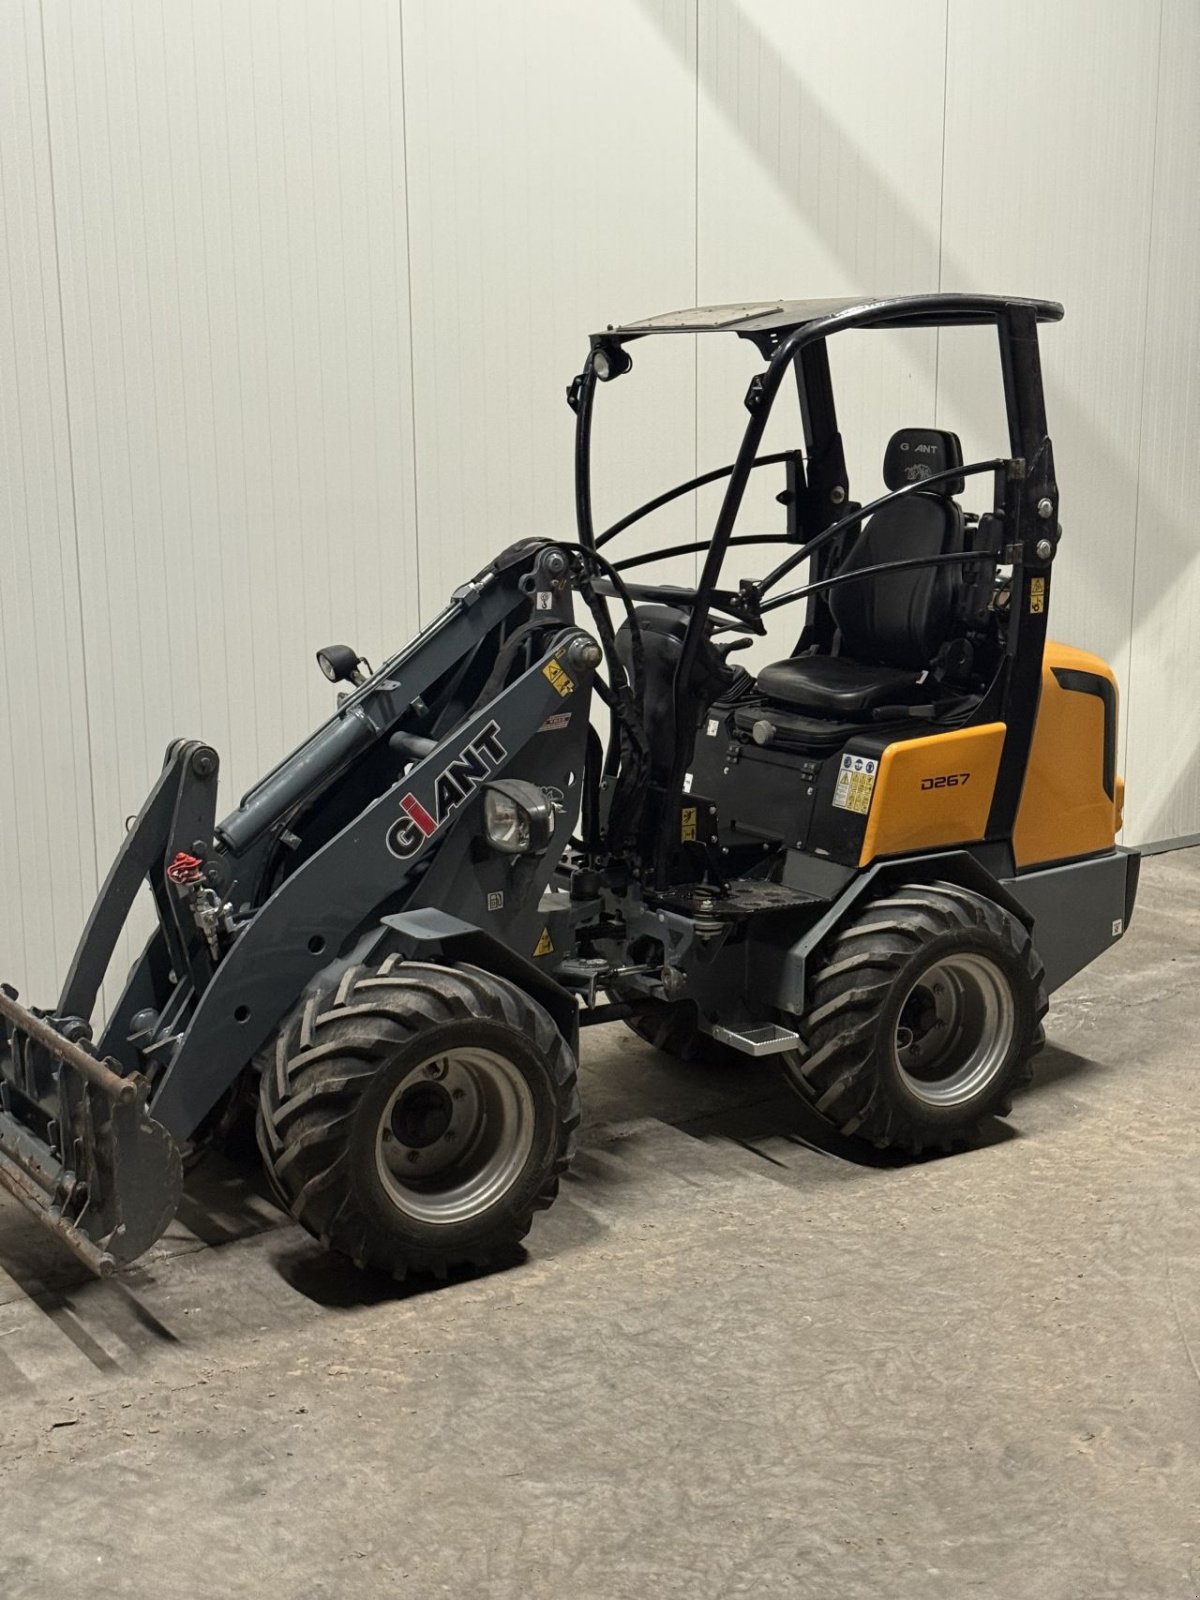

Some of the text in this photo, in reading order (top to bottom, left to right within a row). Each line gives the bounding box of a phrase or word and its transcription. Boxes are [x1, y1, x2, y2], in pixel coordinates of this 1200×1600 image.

[900, 442, 938, 454] GANT
[385, 719, 508, 860] GIANT
[921, 773, 970, 791] D267
